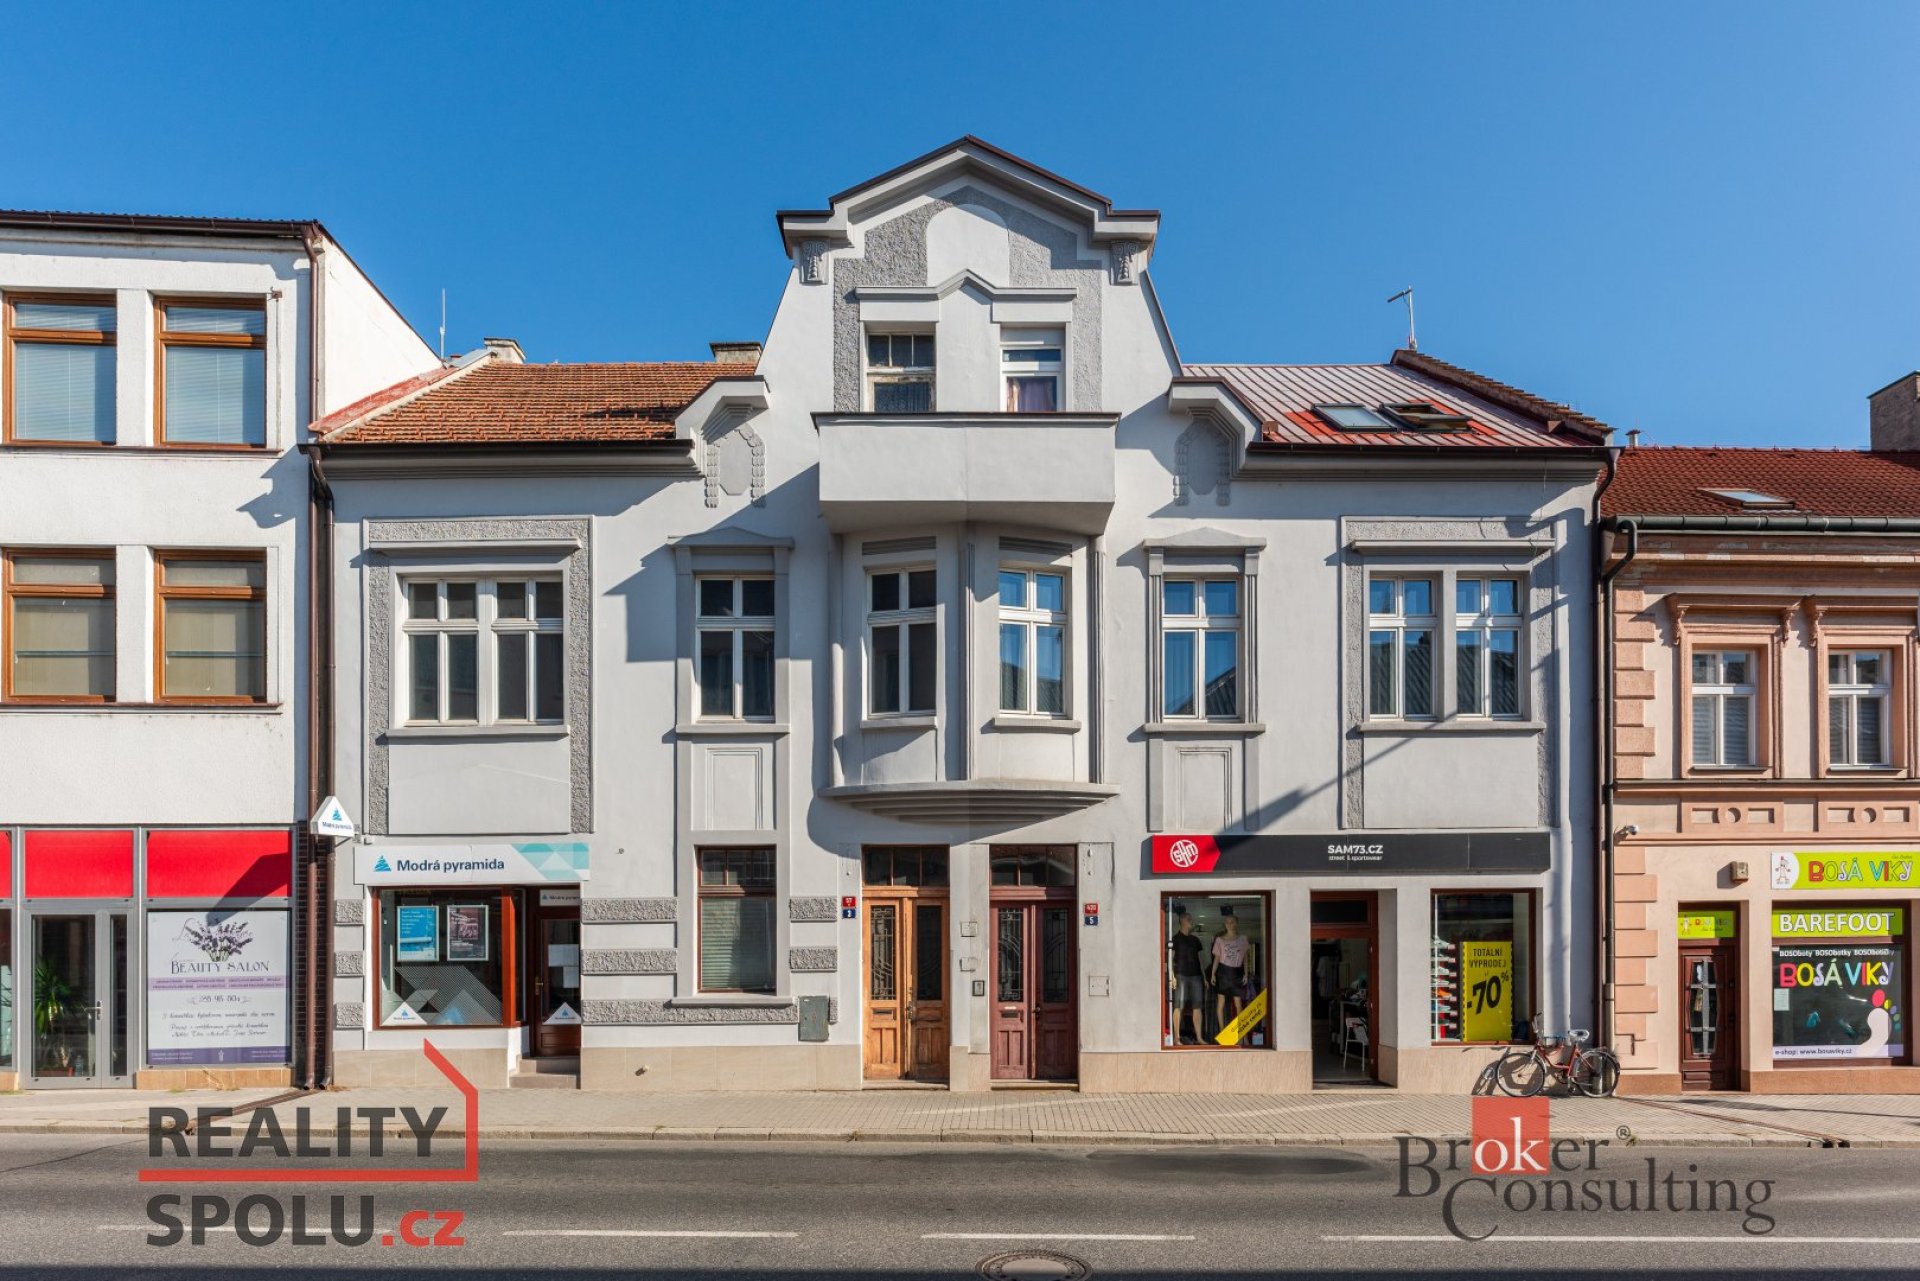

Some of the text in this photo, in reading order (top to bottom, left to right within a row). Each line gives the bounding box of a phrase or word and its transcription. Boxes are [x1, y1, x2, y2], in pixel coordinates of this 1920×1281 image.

[1327, 844, 1383, 854] SAM73.CZ
[397, 858, 505, 873] Modrá pyramida
[1808, 856, 1914, 882] BOSÁ VIKY
[1089, 916, 1095, 925] 5
[1779, 912, 1895, 932] BAREFOOT
[227, 960, 270, 973] SALON
[1780, 957, 1895, 988] BOSÁ VIKY
